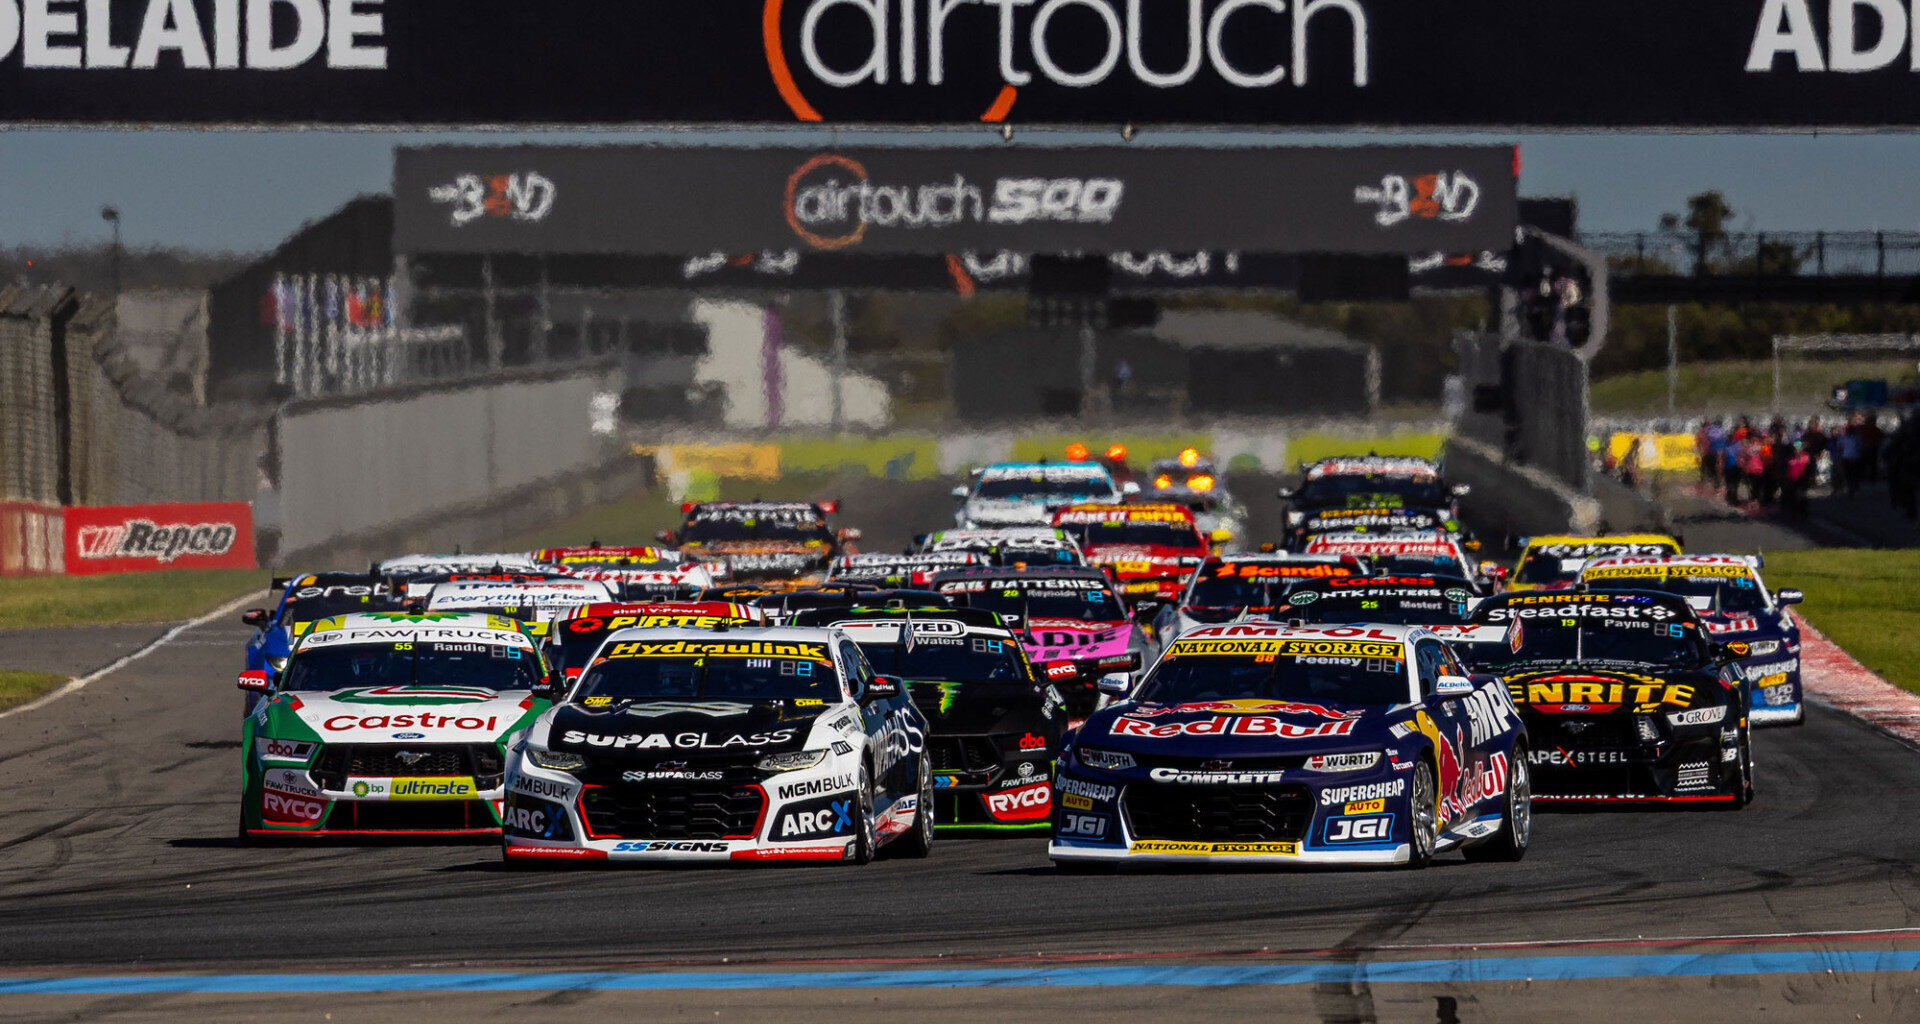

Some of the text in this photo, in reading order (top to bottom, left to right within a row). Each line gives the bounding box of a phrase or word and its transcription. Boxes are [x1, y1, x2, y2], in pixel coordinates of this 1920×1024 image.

[795, 174, 1125, 226] airtouch 500
[120, 519, 236, 562] Repco
[990, 579, 1105, 590] BATTERIES
[1002, 589, 1020, 598] 20
[1321, 588, 1442, 599] NTK FILTERS
[1361, 601, 1379, 610] 25
[1488, 604, 1645, 621] Steadfast
[1560, 618, 1650, 630] 19 Payne
[349, 629, 525, 643] FAW TRUCKS
[915, 637, 964, 646] Waters
[394, 642, 487, 653] 55 Randle
[611, 640, 825, 658] Hydraulink
[1173, 641, 1396, 657] NATIONAL STORAGE
[693, 658, 772, 669] 4 Hill
[1254, 654, 1362, 668] 88 Feeney
[323, 712, 497, 732] Castrol
[1686, 708, 1722, 724] GROVE
[1019, 732, 1046, 749] dba
[1577, 751, 1628, 763] STEEL
[1149, 767, 1283, 784] COMPLETE
[370, 782, 385, 795] bp
[394, 779, 470, 796] ultimate
[1320, 778, 1405, 806] SUPERCHEAP
[263, 792, 324, 821] RYCO
[989, 786, 1051, 813] RYCO
[1065, 796, 1091, 808] AUTO
[1348, 801, 1381, 812] AUTO
[1061, 814, 1106, 836] JGI
[1329, 817, 1390, 841] JGI
[1132, 842, 1293, 854] NATIONAL STORAGE
